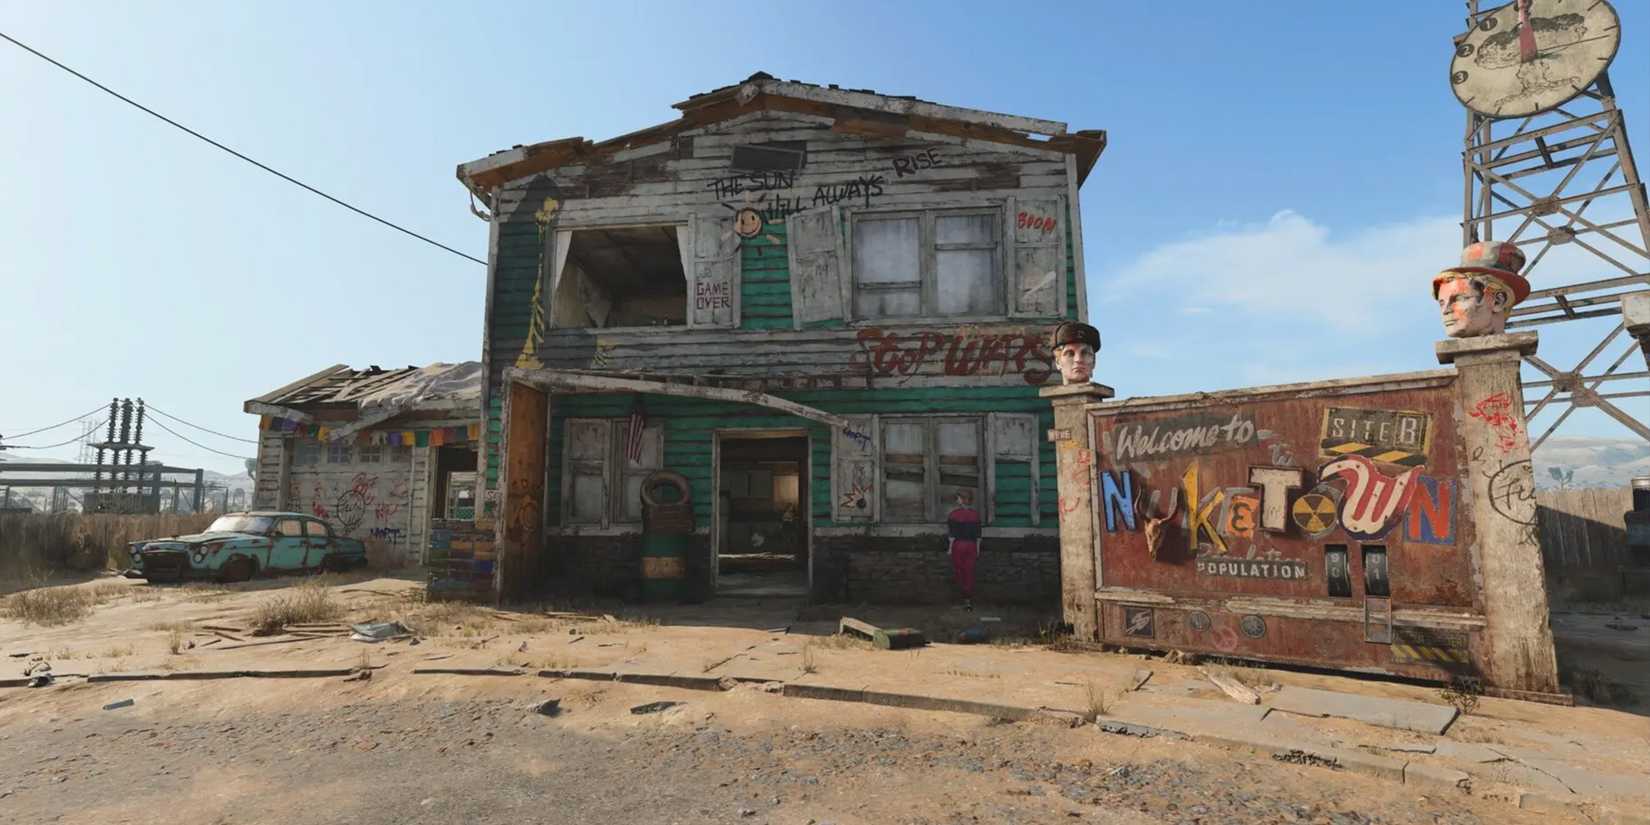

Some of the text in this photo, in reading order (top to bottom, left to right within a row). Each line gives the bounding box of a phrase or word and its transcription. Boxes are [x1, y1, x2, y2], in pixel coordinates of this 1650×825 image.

[707, 169, 798, 200] THE SUN
[812, 175, 883, 208] ALWAYS
[893, 152, 941, 177] RISE
[1017, 211, 1057, 235] BOOM
[697, 282, 728, 296] GAME
[697, 297, 731, 309] OVER
[1116, 424, 1219, 460] Welcome
[1219, 413, 1254, 444] to
[1332, 416, 1419, 445] SITE B
[1196, 561, 1305, 580] POPULATION
